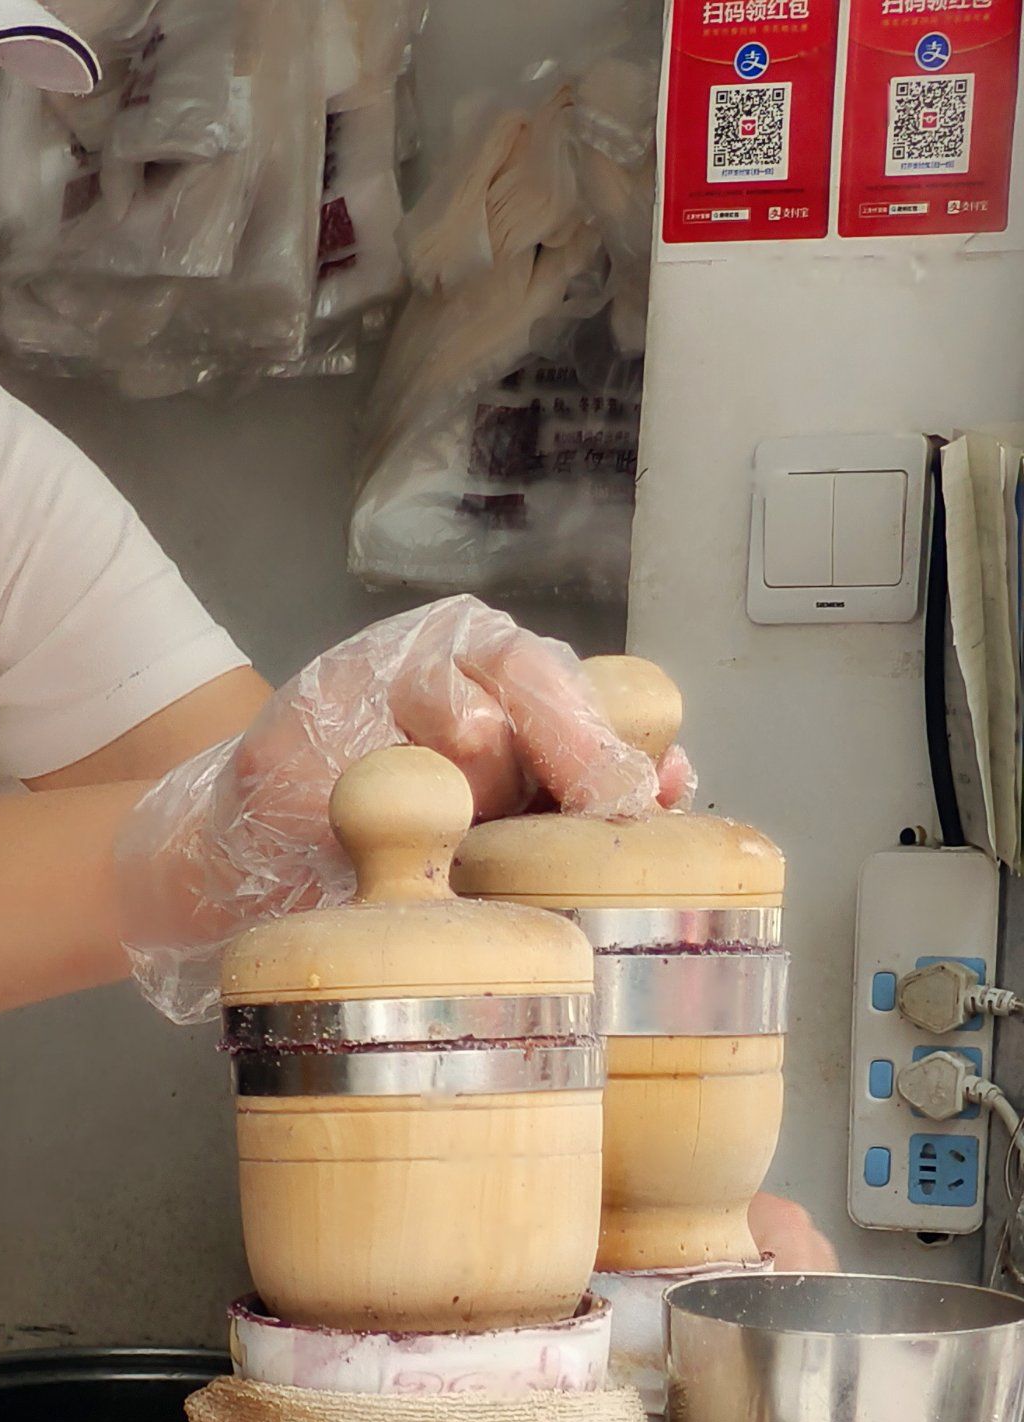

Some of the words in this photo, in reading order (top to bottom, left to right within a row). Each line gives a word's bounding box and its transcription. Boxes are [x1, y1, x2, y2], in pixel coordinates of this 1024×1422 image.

[703, 0, 810, 25] 扫码领红包
